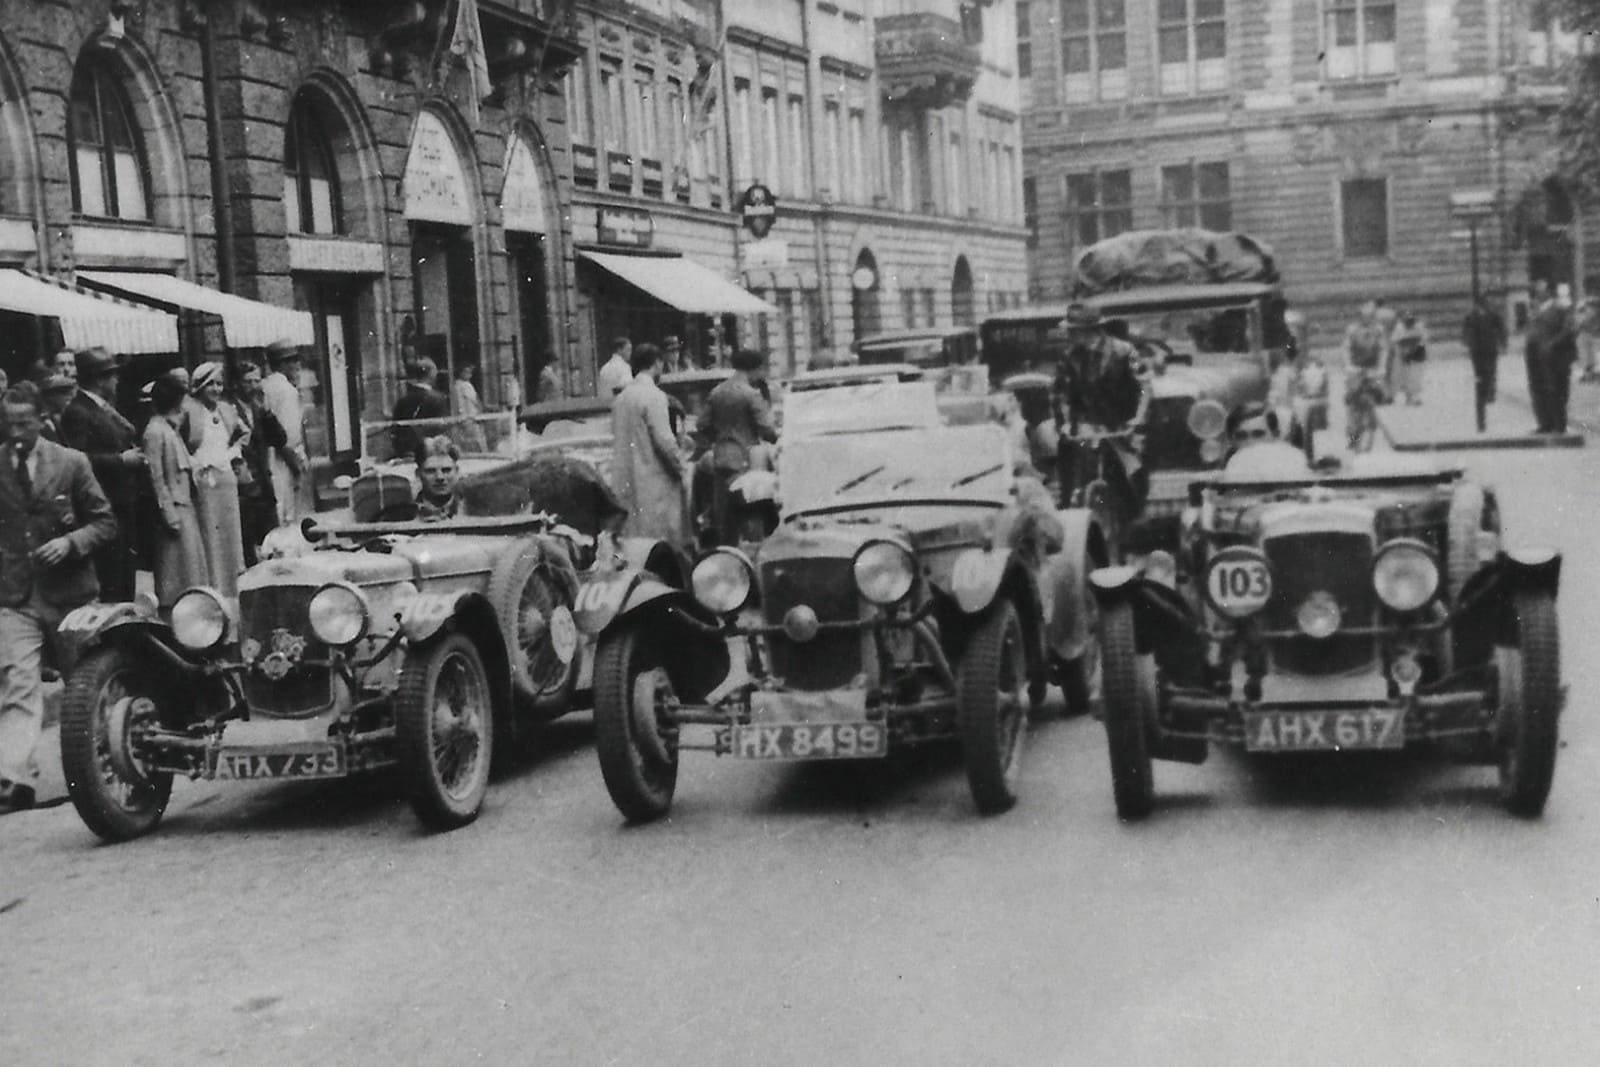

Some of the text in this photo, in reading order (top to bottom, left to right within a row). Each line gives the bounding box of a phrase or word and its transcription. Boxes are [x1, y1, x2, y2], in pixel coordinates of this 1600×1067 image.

[1219, 566, 1268, 598] 103
[791, 725, 881, 757] 8499
[1256, 709, 1397, 747] AHX 617
